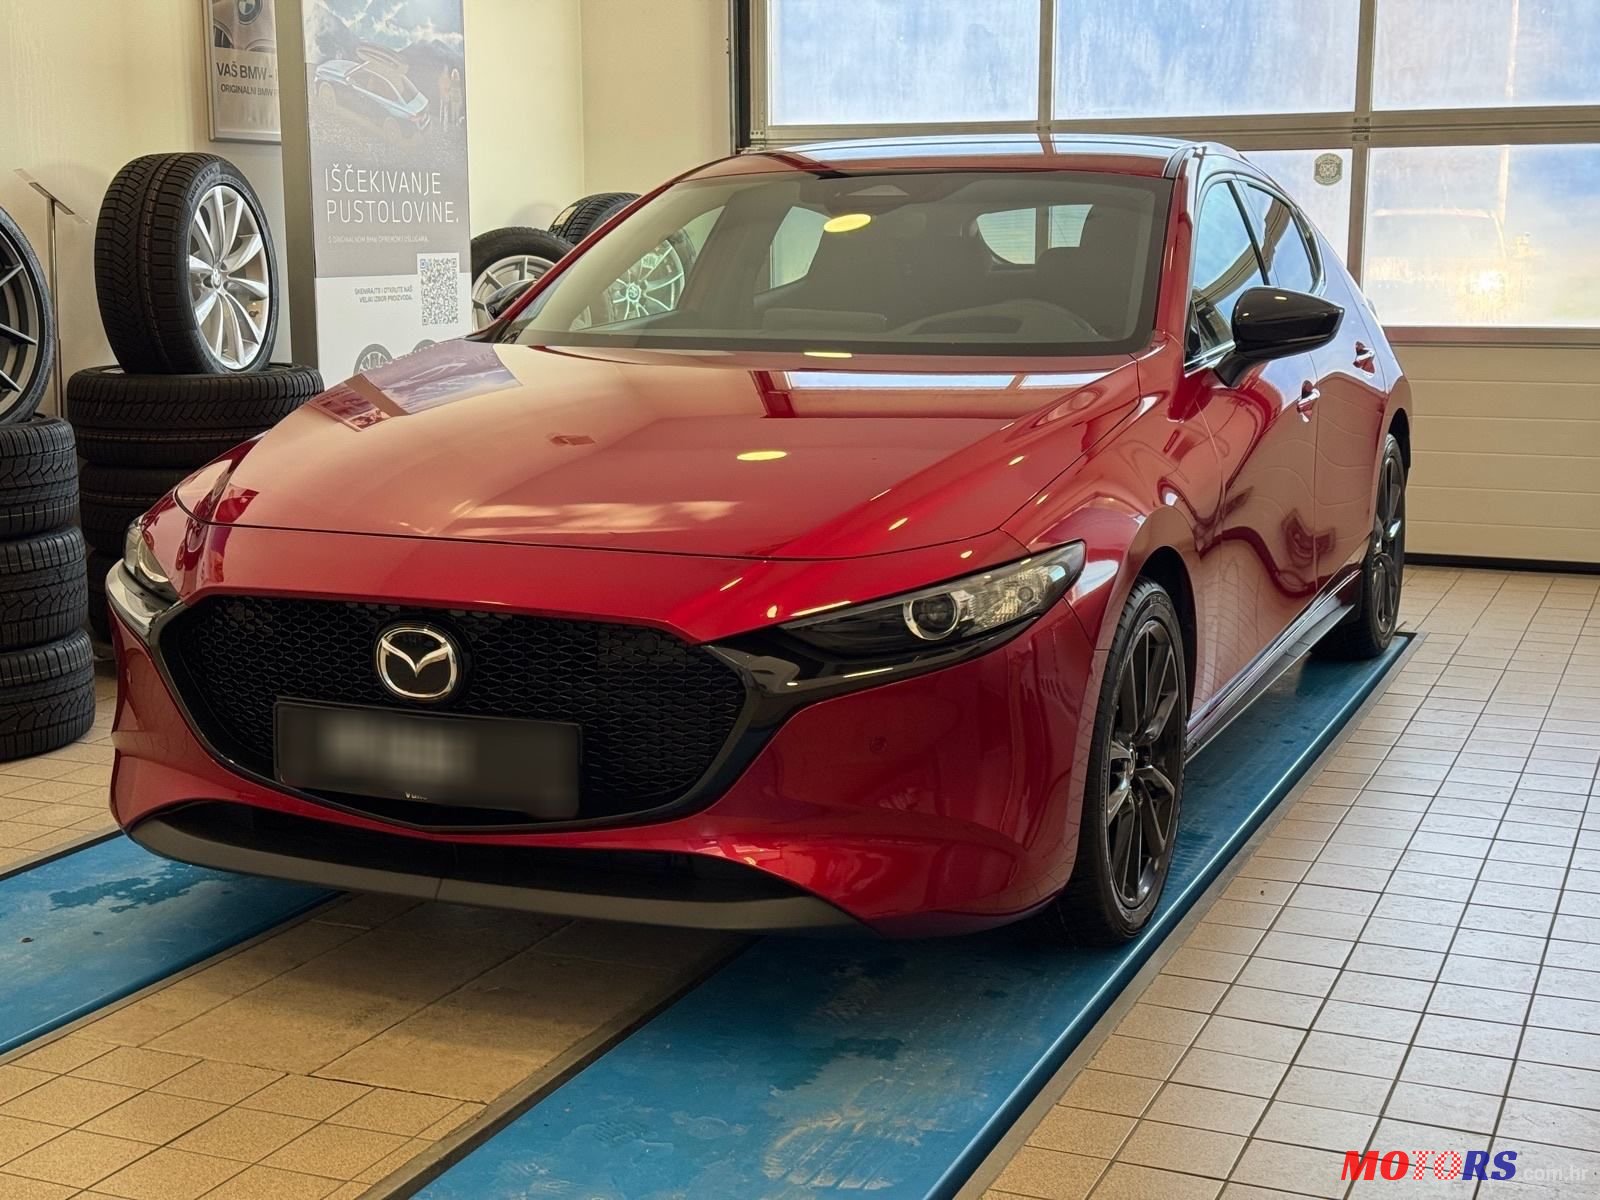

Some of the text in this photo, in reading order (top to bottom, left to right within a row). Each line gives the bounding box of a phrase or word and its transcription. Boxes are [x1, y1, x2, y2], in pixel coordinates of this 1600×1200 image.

[216, 61, 238, 77] VAŠ
[240, 65, 267, 80] BMW
[325, 163, 441, 196] IŠČEKIVANJE
[326, 199, 459, 223] PUSTOLOVINE.
